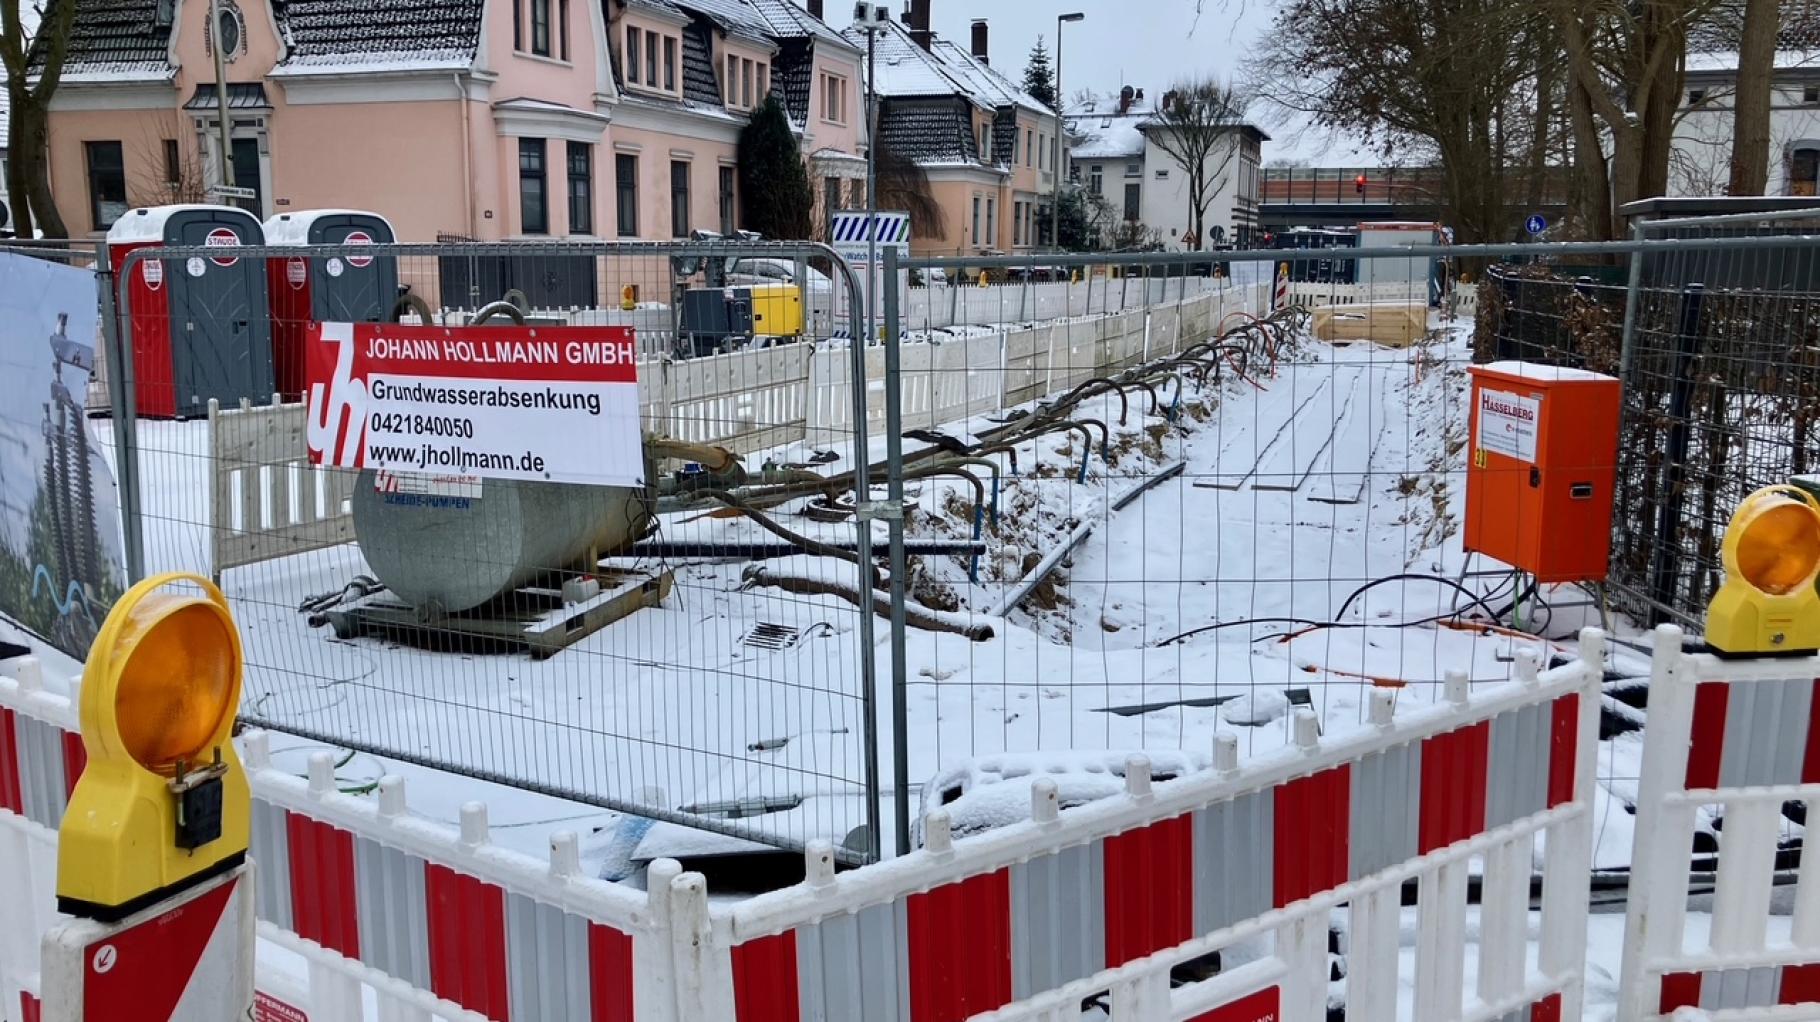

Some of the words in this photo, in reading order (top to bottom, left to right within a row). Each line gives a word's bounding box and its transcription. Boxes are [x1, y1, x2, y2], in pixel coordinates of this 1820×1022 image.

[207, 237, 238, 246] STAUDE
[366, 338, 440, 361] JOHANN
[444, 340, 559, 364] HOLLMANN
[565, 341, 635, 365] GMBH
[372, 380, 602, 415] Grundwasserabsenkung
[1482, 394, 1533, 420] HASSELBERG
[371, 412, 474, 439] 0421840050
[370, 444, 545, 473] www.jhollmann.de
[255, 993, 304, 1021] FFERMANN
